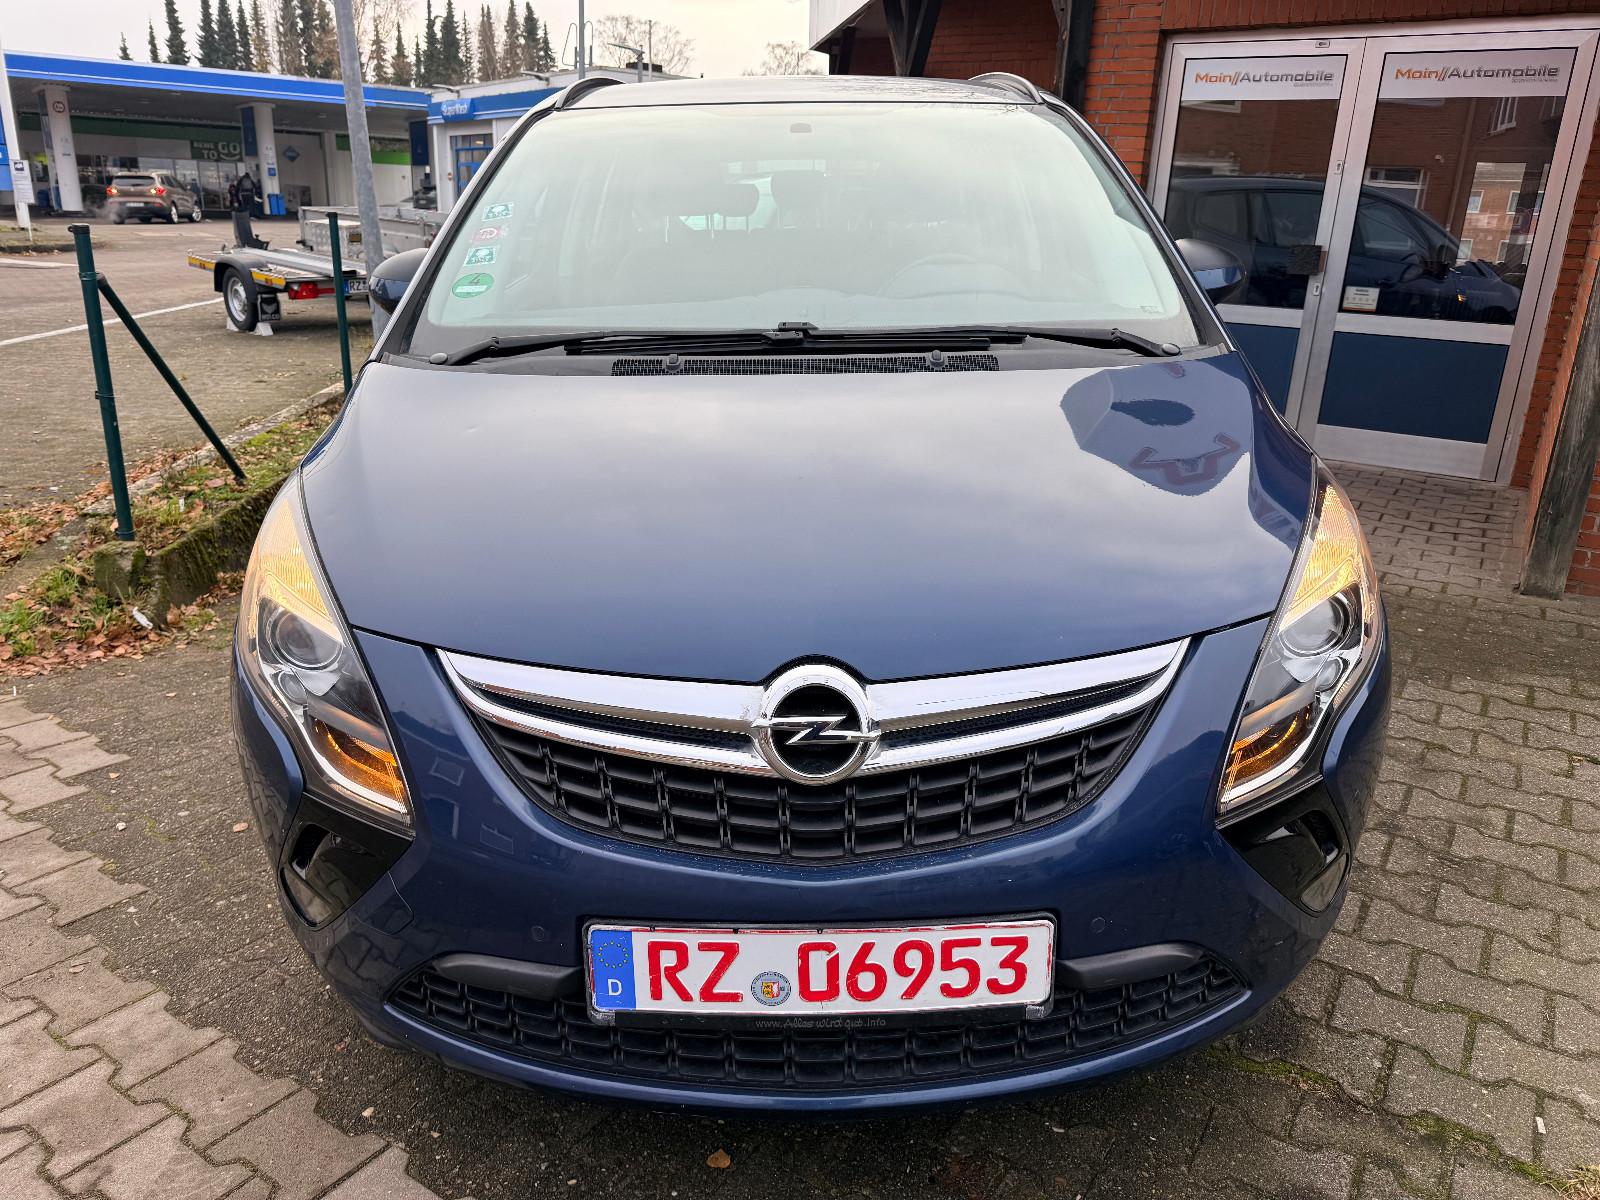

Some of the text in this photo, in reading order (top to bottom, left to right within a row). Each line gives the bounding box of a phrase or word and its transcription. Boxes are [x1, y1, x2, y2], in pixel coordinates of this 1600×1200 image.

[218, 141, 241, 154] GO
[350, 280, 362, 291] RZ
[648, 940, 744, 1002] RZ
[797, 935, 1029, 1002] 06953
[608, 978, 622, 996] D
